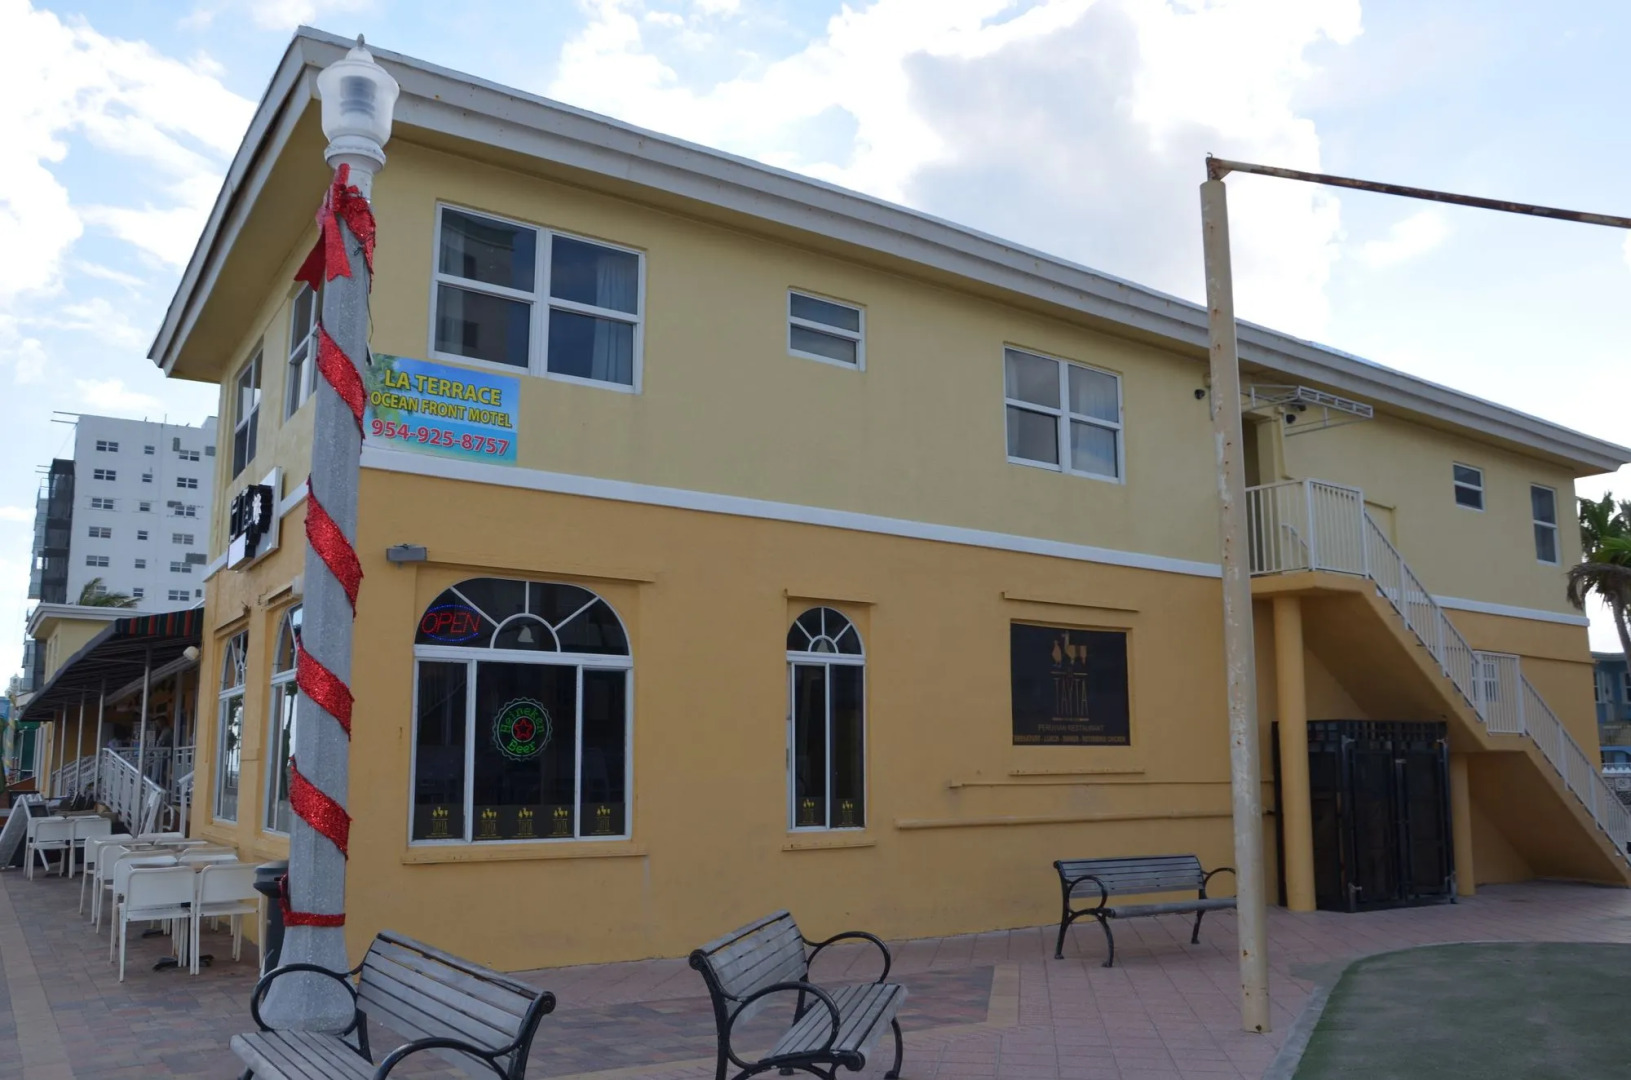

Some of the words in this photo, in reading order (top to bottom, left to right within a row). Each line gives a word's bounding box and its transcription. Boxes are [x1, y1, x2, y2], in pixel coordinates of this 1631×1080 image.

[384, 369, 411, 390] LA
[415, 374, 503, 406] TERRACE
[370, 391, 419, 413] OCEAN
[421, 399, 466, 420] FRONT
[468, 407, 513, 428] MOTEL
[371, 418, 510, 456] 954-925-8757
[421, 612, 481, 634] OPEN
[500, 707, 546, 735] Heineken
[507, 738, 537, 754] Beer
